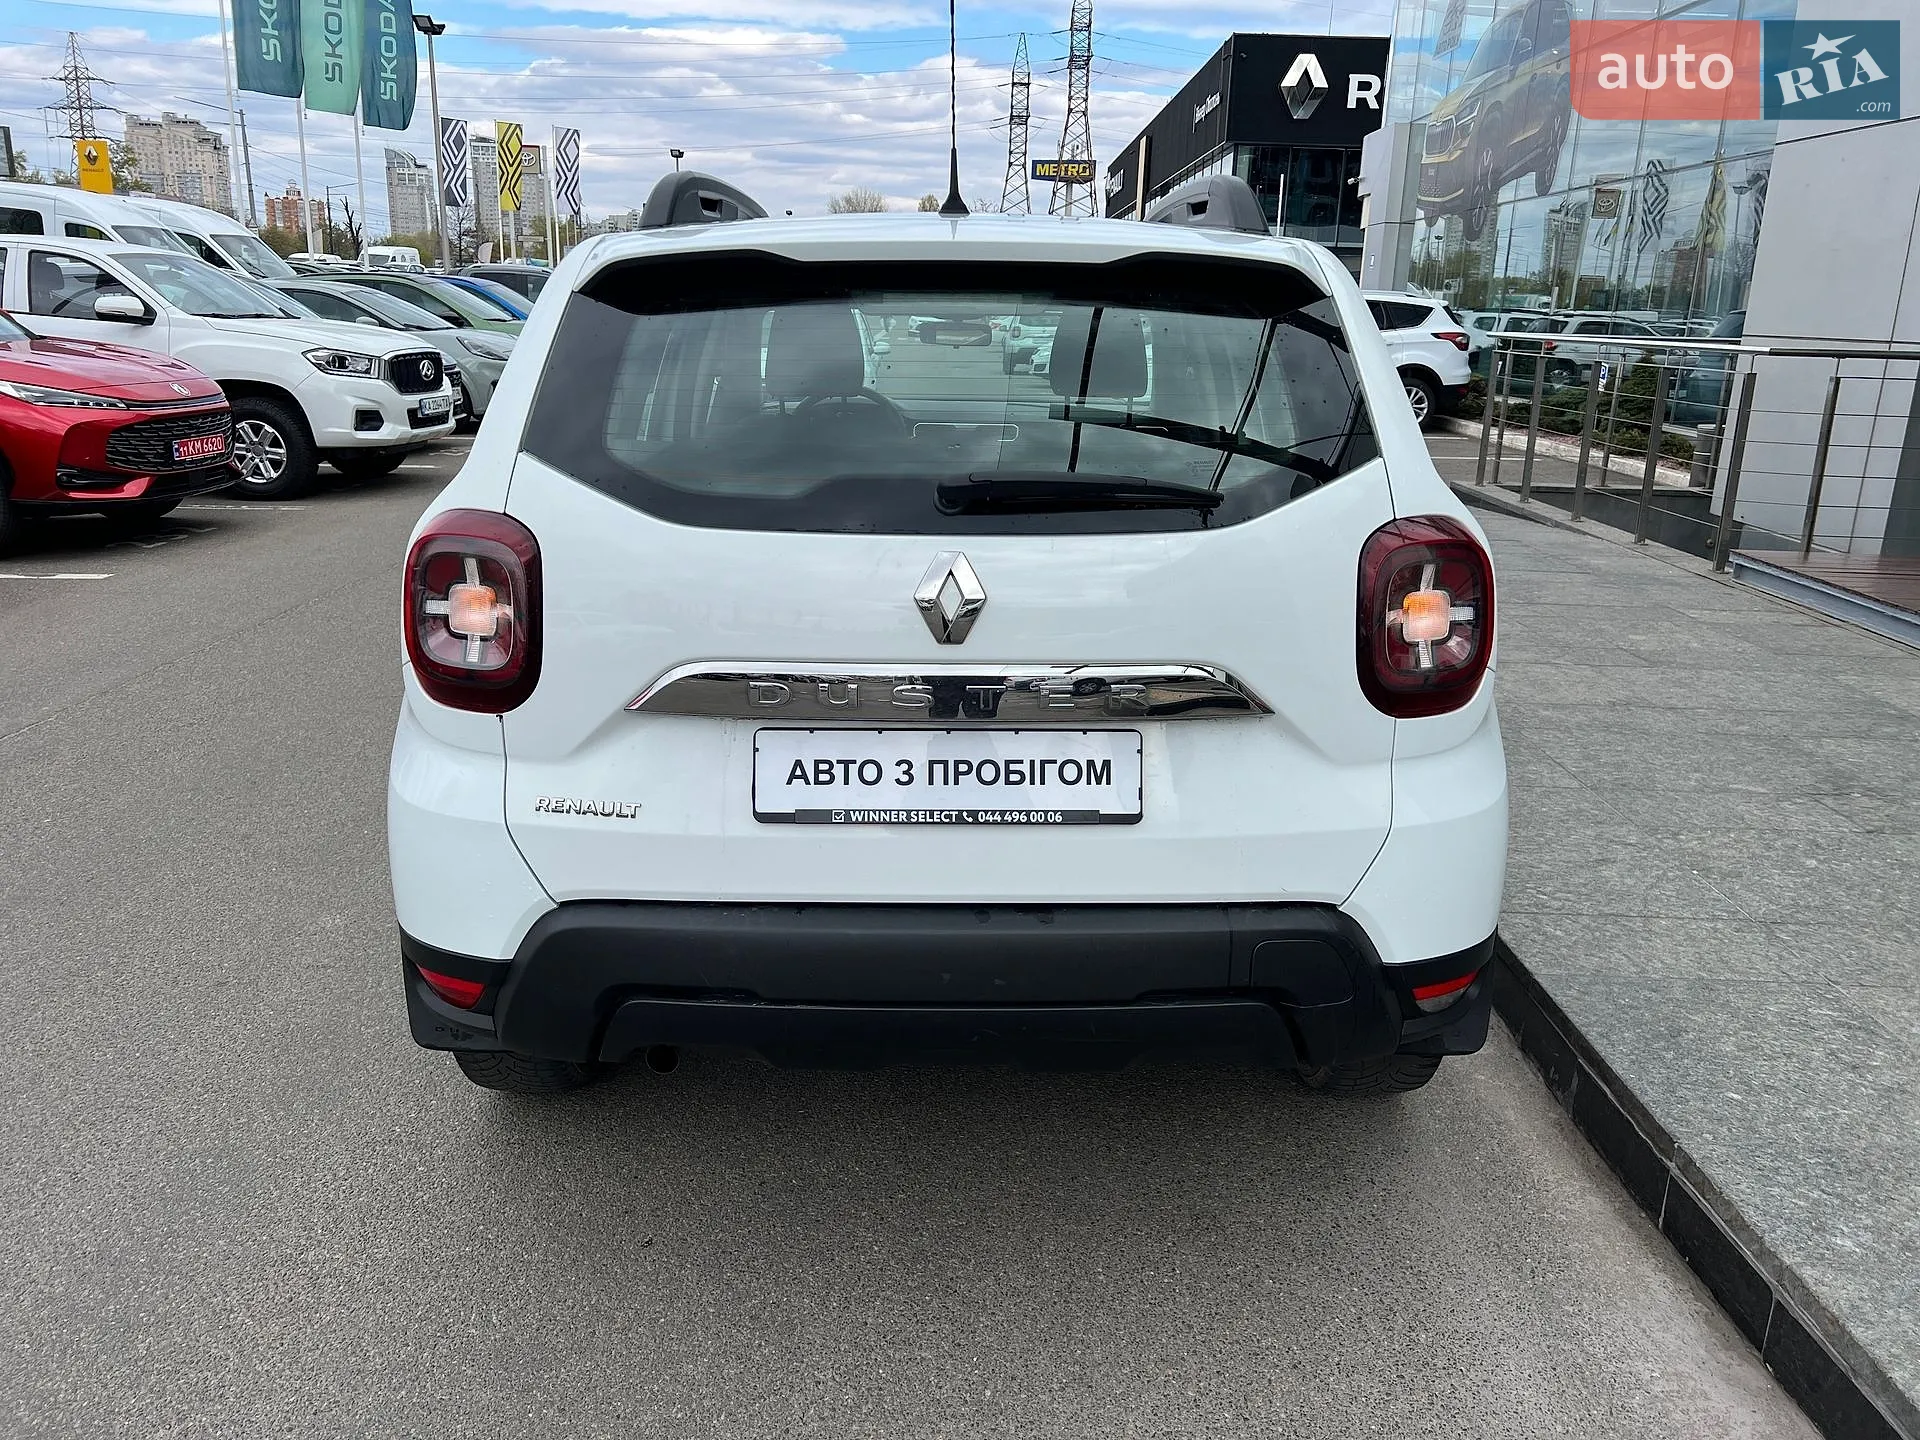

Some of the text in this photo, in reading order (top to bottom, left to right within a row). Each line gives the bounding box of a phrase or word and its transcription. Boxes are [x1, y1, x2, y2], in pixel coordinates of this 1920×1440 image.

[1036, 163, 1091, 176] METRO
[203, 437, 222, 452] 6620
[748, 681, 1149, 711] DUSTER
[786, 759, 883, 786] АВТО
[927, 759, 1112, 786] ПРОБІГОМ
[535, 796, 641, 819] RENAULT
[850, 811, 1063, 823] WINNER SELECT 044 496 00 06
